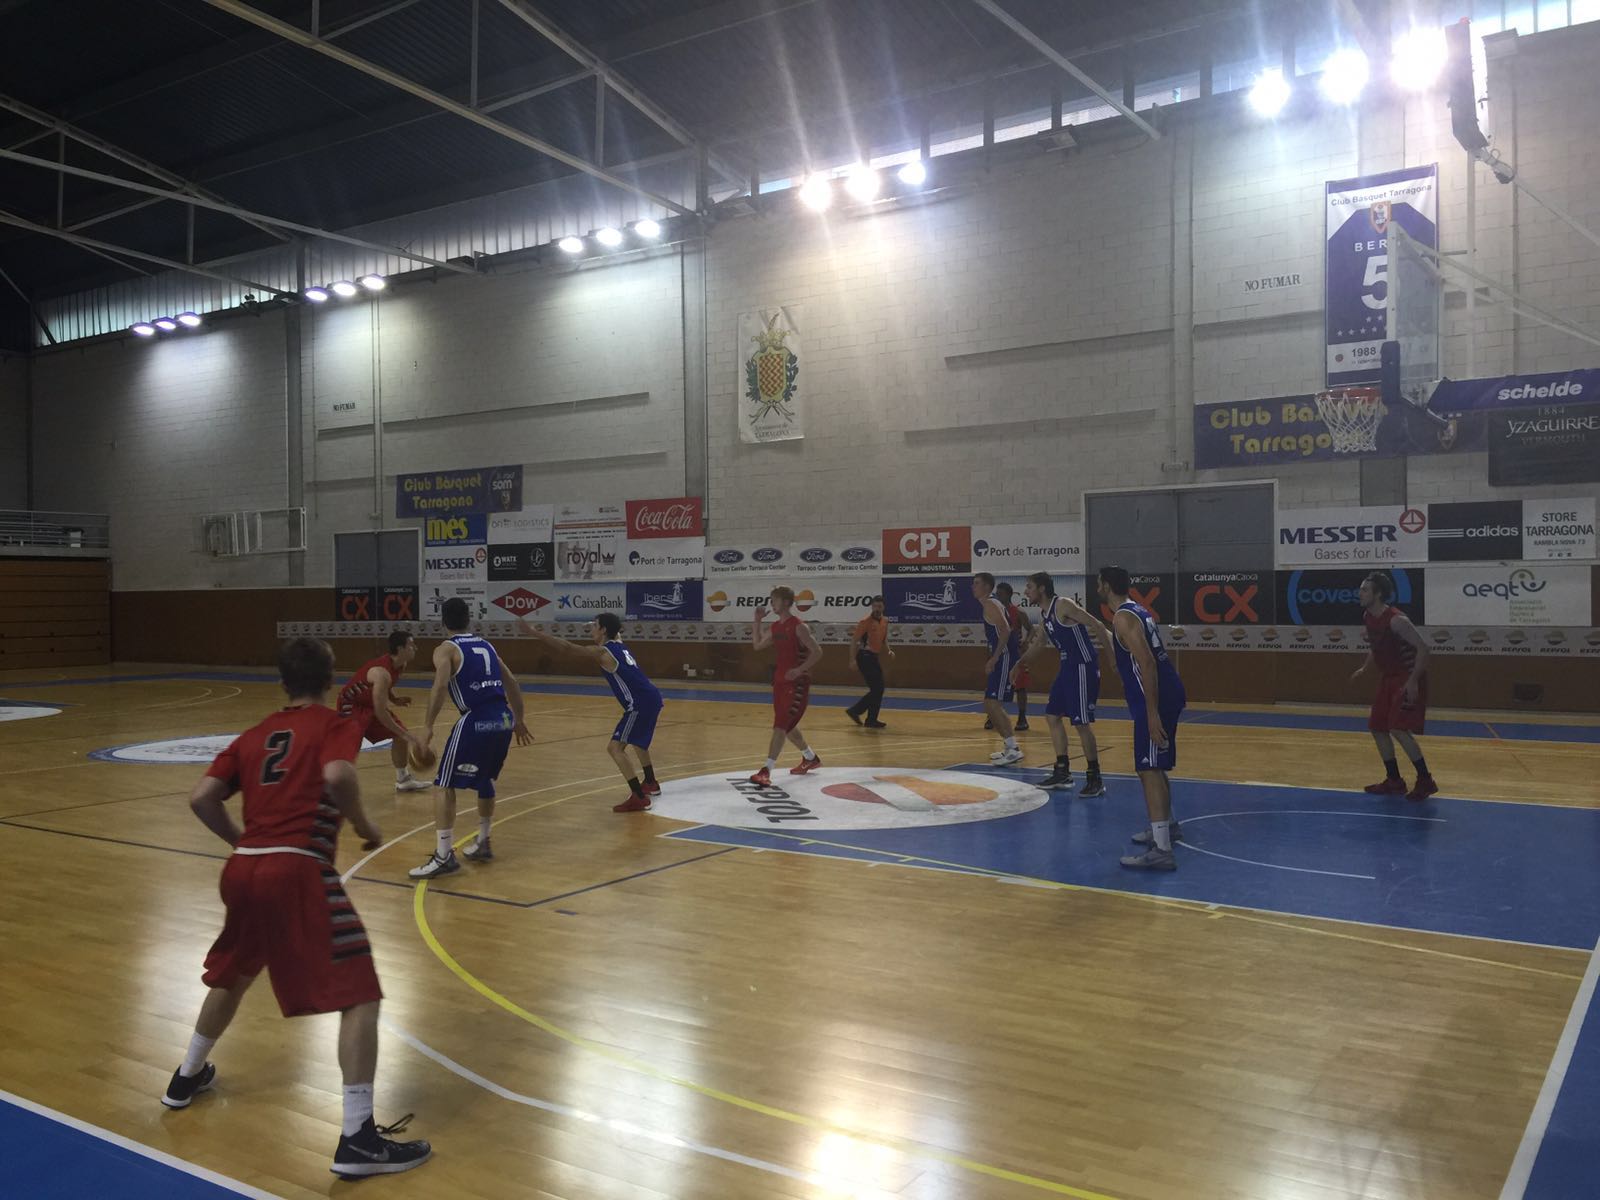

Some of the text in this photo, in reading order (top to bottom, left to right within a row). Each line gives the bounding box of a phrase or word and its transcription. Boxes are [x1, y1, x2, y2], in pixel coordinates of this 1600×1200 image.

[1331, 198, 1350, 206] Club
[1389, 184, 1432, 197] Tarragona
[1354, 240, 1388, 252] BER
[1245, 274, 1300, 292] NO FUMAR
[1352, 347, 1376, 357] 1988
[1498, 381, 1583, 400] schelde
[1210, 407, 1271, 429] Club
[1538, 408, 1564, 416] 1884
[1230, 434, 1332, 456] Tarrago
[404, 477, 432, 492] Club
[412, 495, 473, 512] Tarragona
[636, 504, 695, 532] Coca-Cola
[1542, 512, 1577, 522] STORE
[1280, 525, 1397, 544] MESSER
[1466, 525, 1520, 538] adidas
[1526, 524, 1594, 536] TARRAGONA
[899, 532, 950, 559] CPI
[990, 546, 1080, 558] Port de Tarragona
[567, 544, 600, 569] royal
[758, 550, 777, 561] Ford
[806, 550, 826, 562] Ford
[848, 550, 868, 560] Ford
[1314, 547, 1397, 560] Gases for Life
[426, 557, 475, 570] MESSER
[641, 556, 702, 566] Port de Tarragona
[1194, 573, 1258, 582] CatalunyaCaixa
[342, 596, 368, 620] CX
[384, 594, 413, 620] CX
[573, 594, 624, 608] CaixaBank
[736, 596, 772, 607] REPS
[824, 596, 873, 607] REPSO
[1194, 585, 1258, 624] CX
[472, 647, 491, 676] 7
[260, 728, 295, 786] 2
